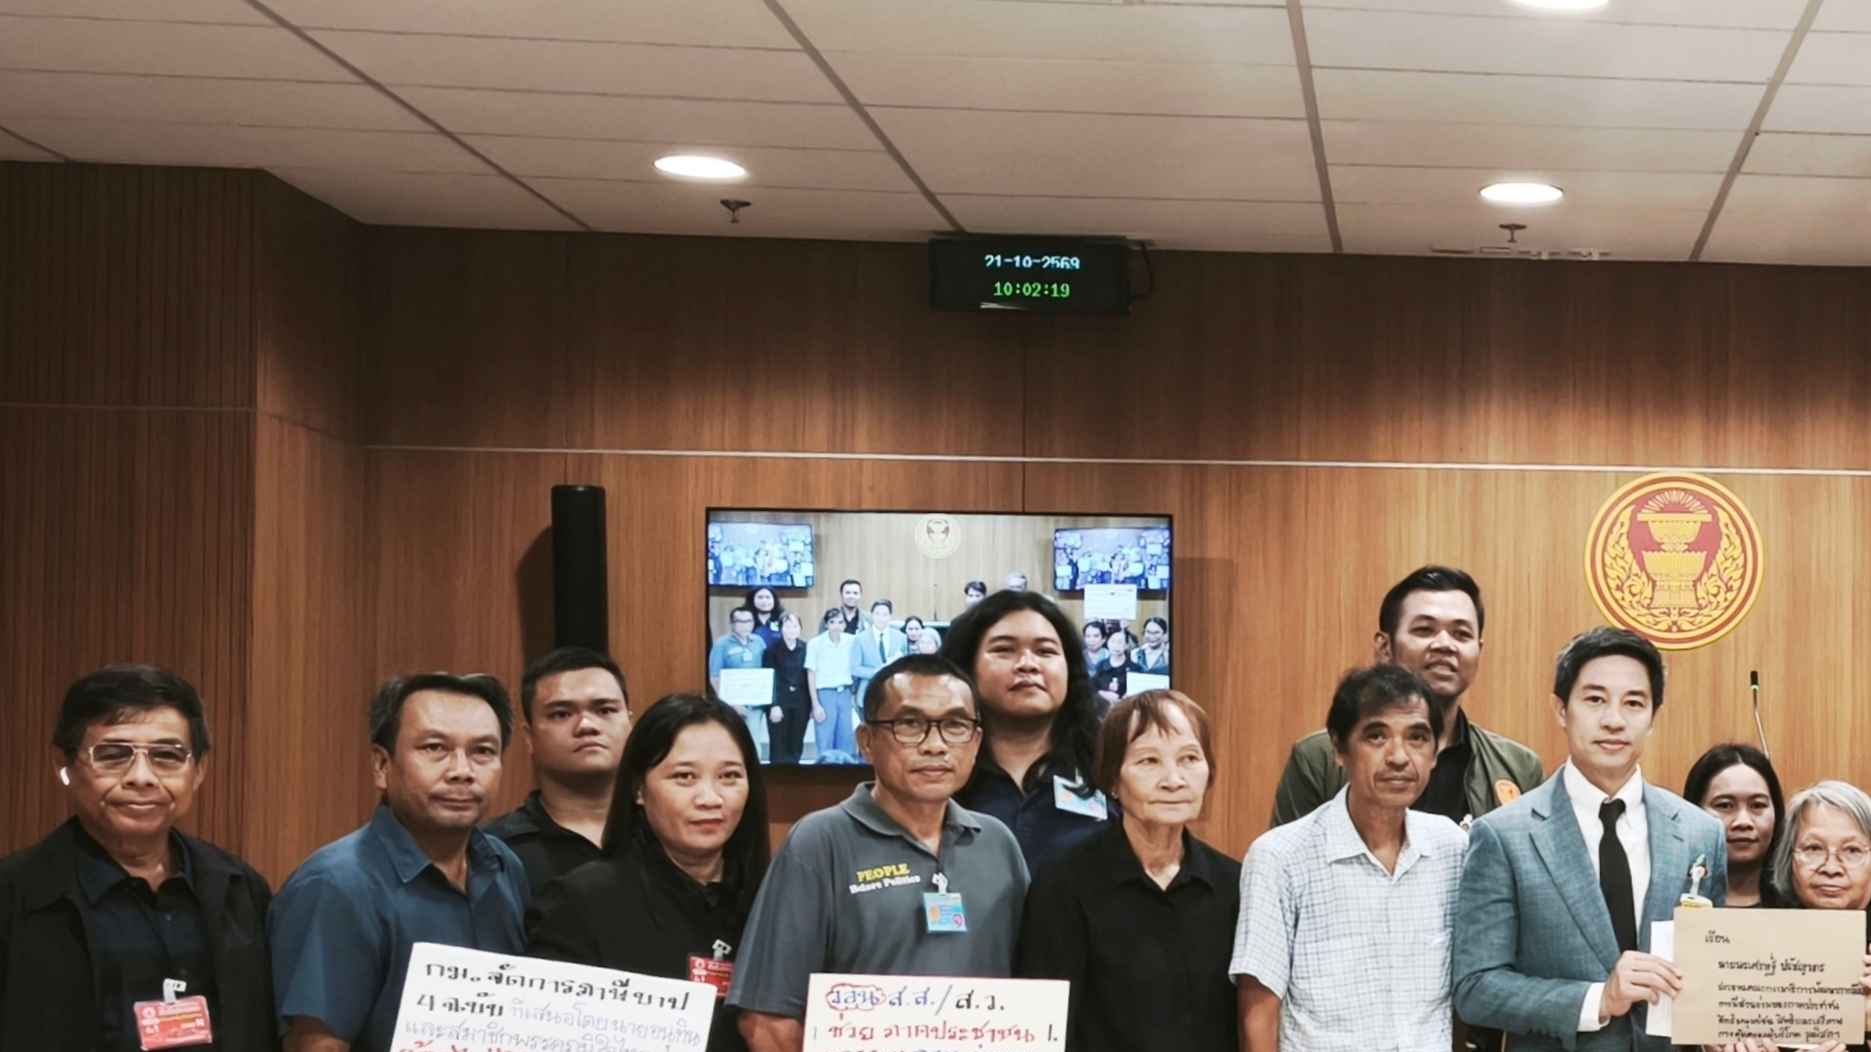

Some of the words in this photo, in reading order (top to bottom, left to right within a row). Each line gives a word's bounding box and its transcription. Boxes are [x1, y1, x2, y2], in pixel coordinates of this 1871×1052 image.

[984, 254, 1080, 270] 21-10-2569
[993, 281, 1070, 298] 10:02:19
[856, 863, 912, 882] PEOPLE
